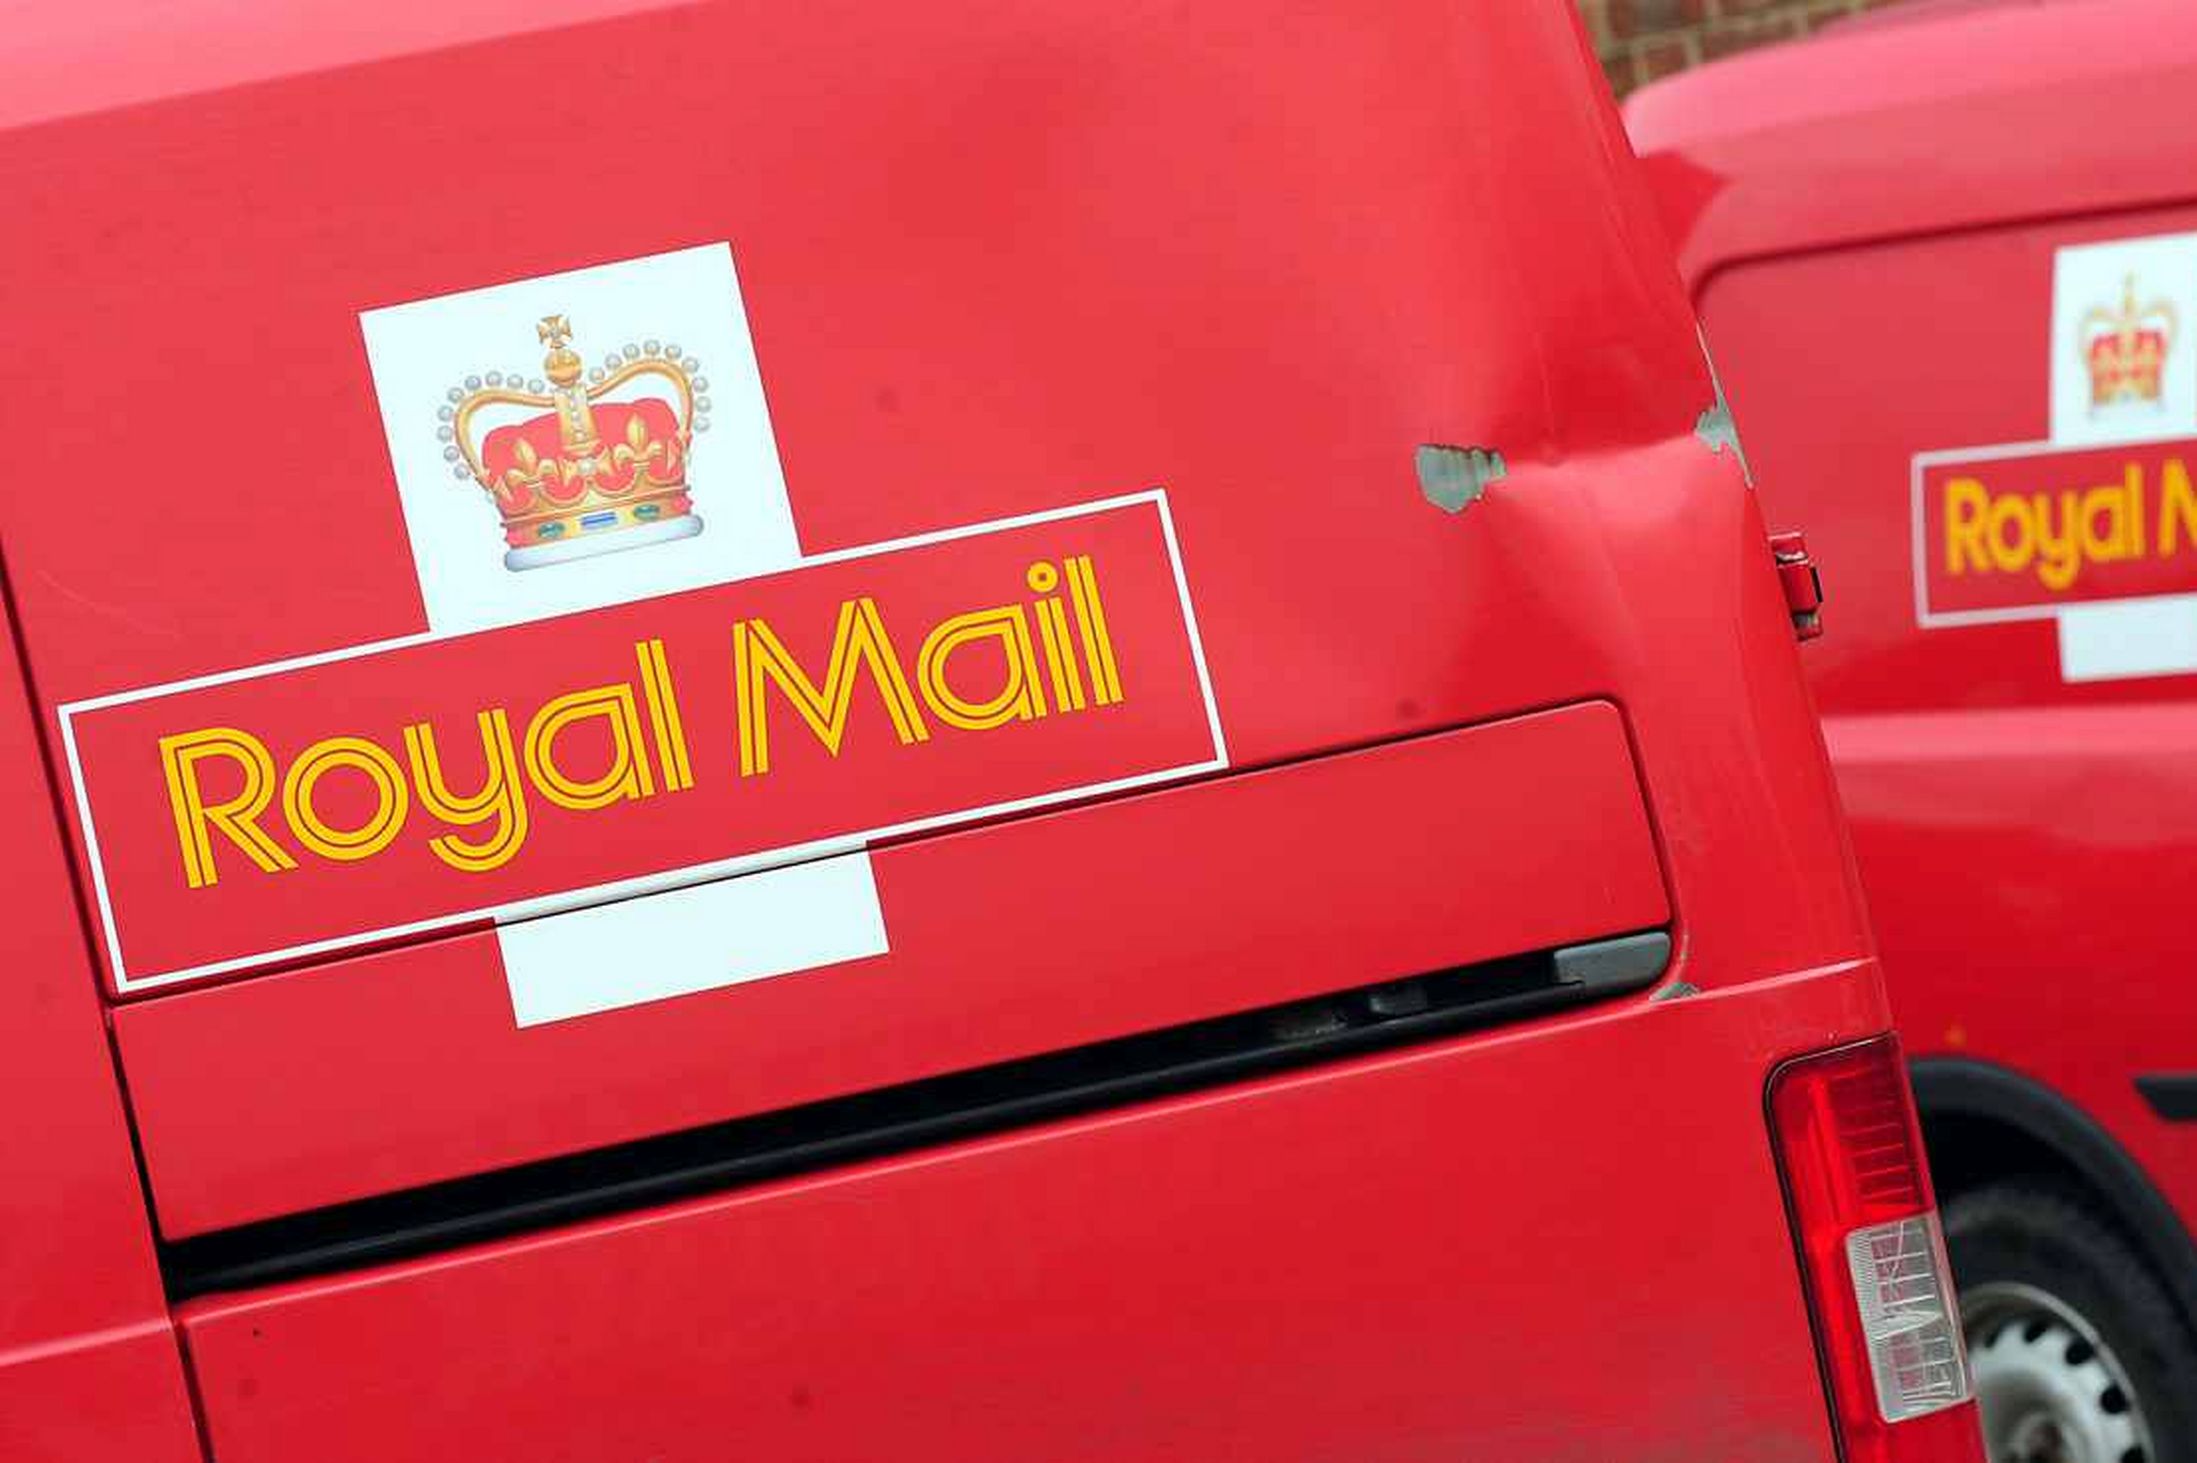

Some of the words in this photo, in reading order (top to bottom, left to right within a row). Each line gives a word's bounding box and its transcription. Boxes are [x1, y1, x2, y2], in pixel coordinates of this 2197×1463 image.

[1944, 464, 2147, 589] Royal
[160, 638, 694, 889] Royal
[734, 556, 1124, 777] Mail
